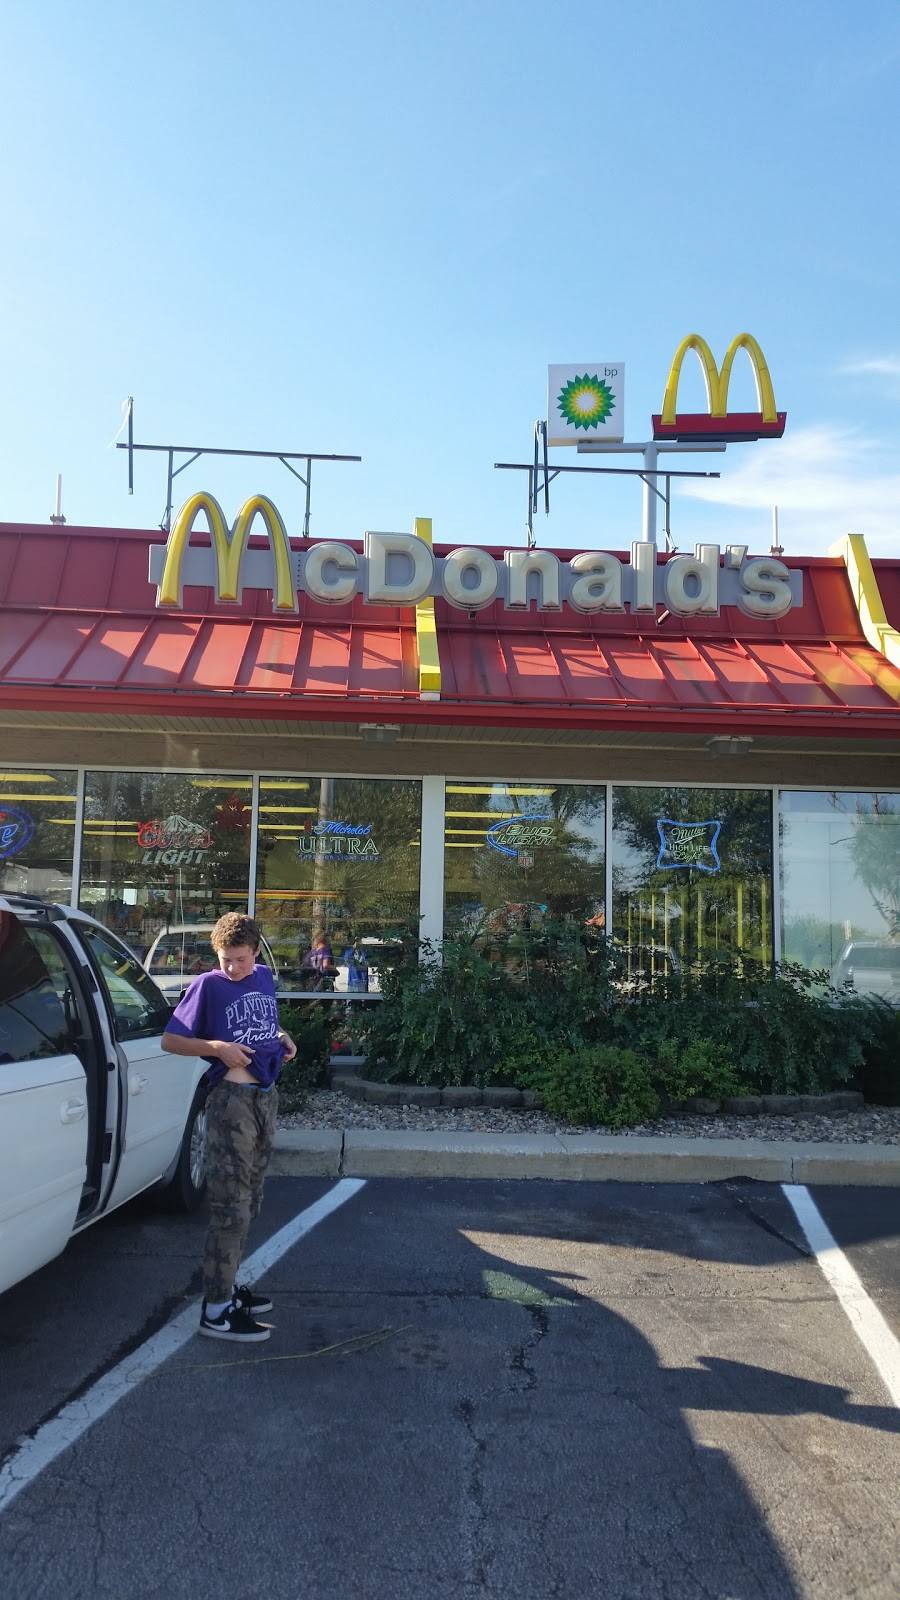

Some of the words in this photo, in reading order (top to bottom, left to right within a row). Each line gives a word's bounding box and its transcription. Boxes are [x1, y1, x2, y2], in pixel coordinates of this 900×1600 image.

[604, 367, 618, 379] bp
[156, 491, 796, 619] McDonald's
[313, 820, 373, 835] Michelob
[506, 824, 554, 836] BUD
[671, 826, 707, 842] Miller
[299, 836, 379, 855] ULTRA
[496, 835, 557, 846] LIGHT
[669, 843, 688, 851] HIGH
[690, 841, 709, 852] LIFE
[142, 849, 208, 865] LIGHT
[225, 996, 278, 1029] PLAYOFF
